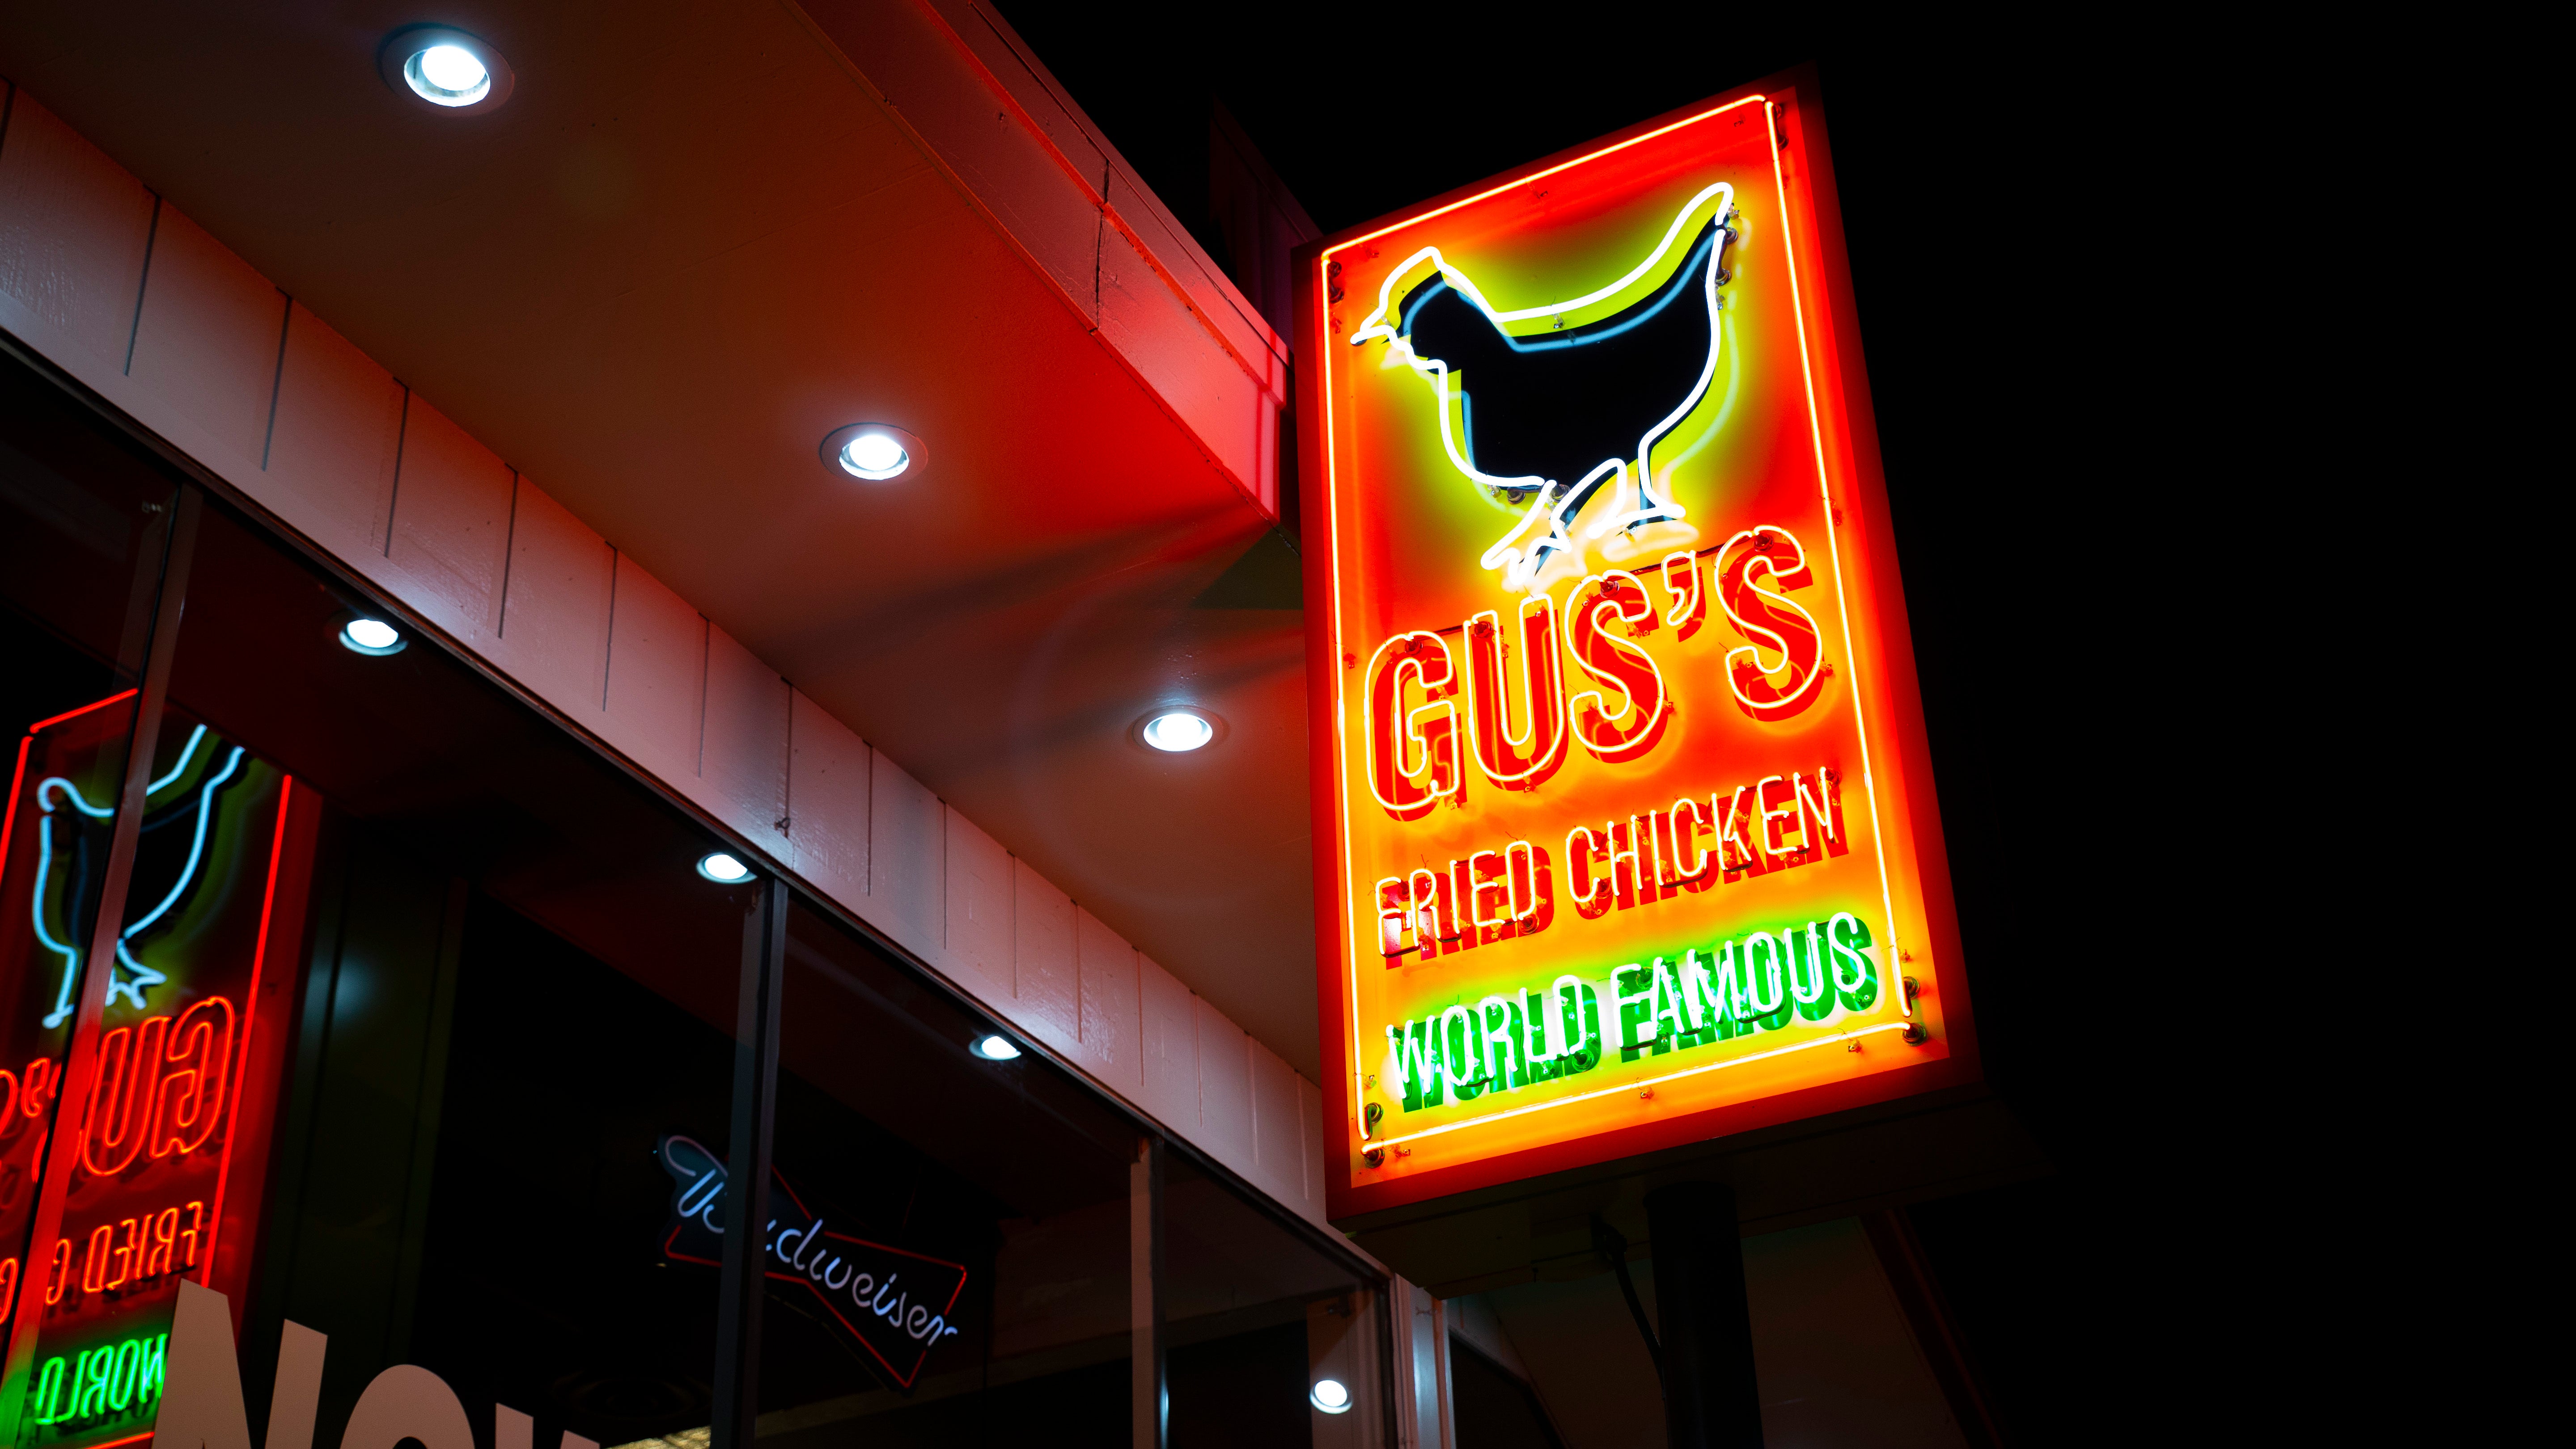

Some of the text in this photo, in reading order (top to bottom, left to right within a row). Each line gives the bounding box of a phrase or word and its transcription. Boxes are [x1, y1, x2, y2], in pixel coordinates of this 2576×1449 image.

[1364, 525, 1826, 822] GUS'S
[1375, 766, 1850, 969] FRIED CHICKEN
[1385, 912, 1880, 1113] WORLD FAMOUS
[665, 1135, 958, 1346] Bdweiser
